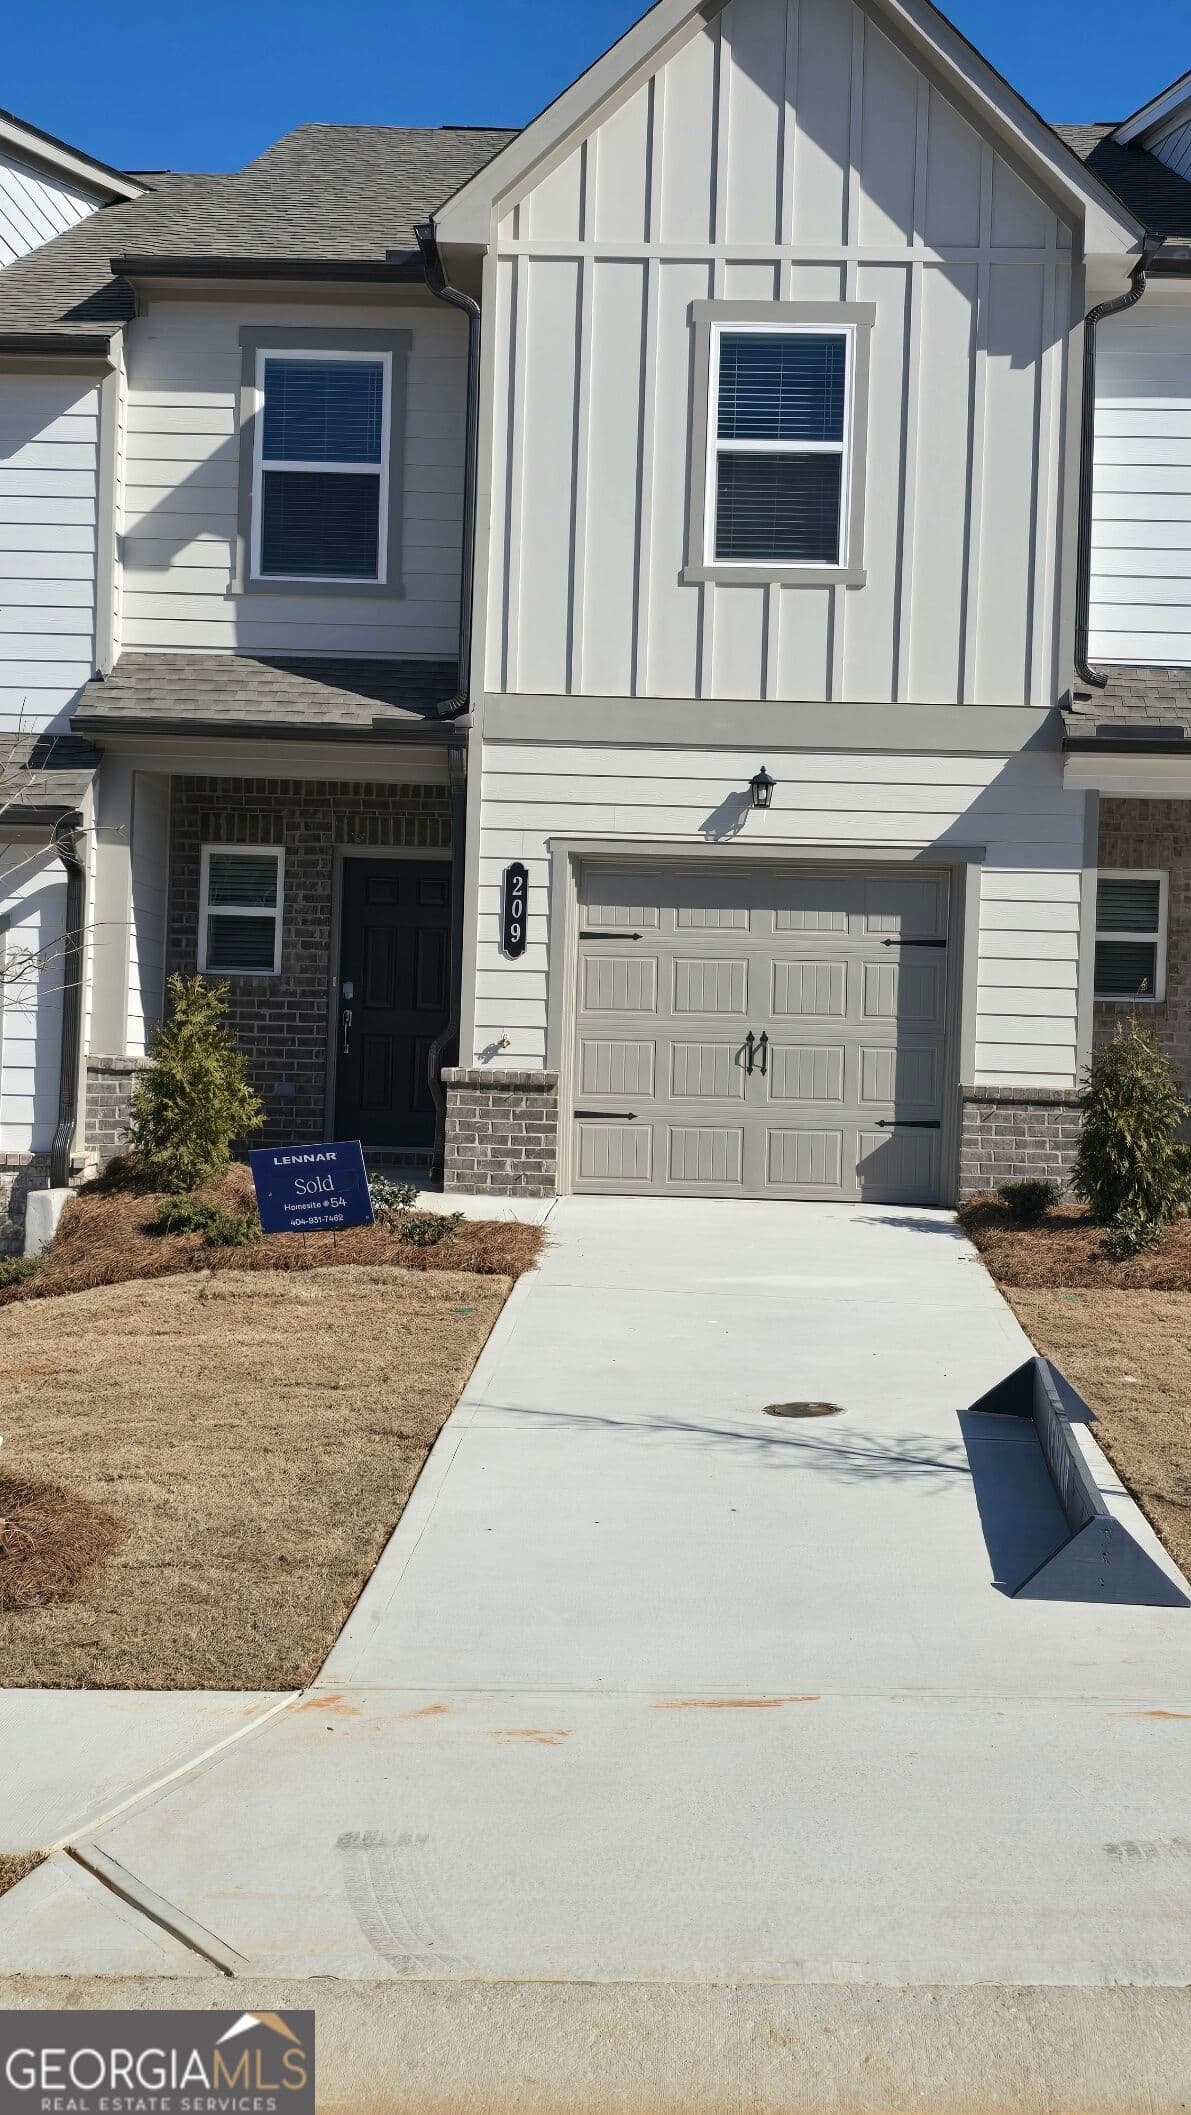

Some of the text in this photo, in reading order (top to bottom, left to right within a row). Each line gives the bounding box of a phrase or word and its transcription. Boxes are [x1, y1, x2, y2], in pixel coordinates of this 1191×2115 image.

[510, 876, 523, 943] 209
[273, 1152, 337, 1165] LENNAR
[294, 1174, 335, 1195] Sold
[283, 1202, 322, 1211] Homesite
